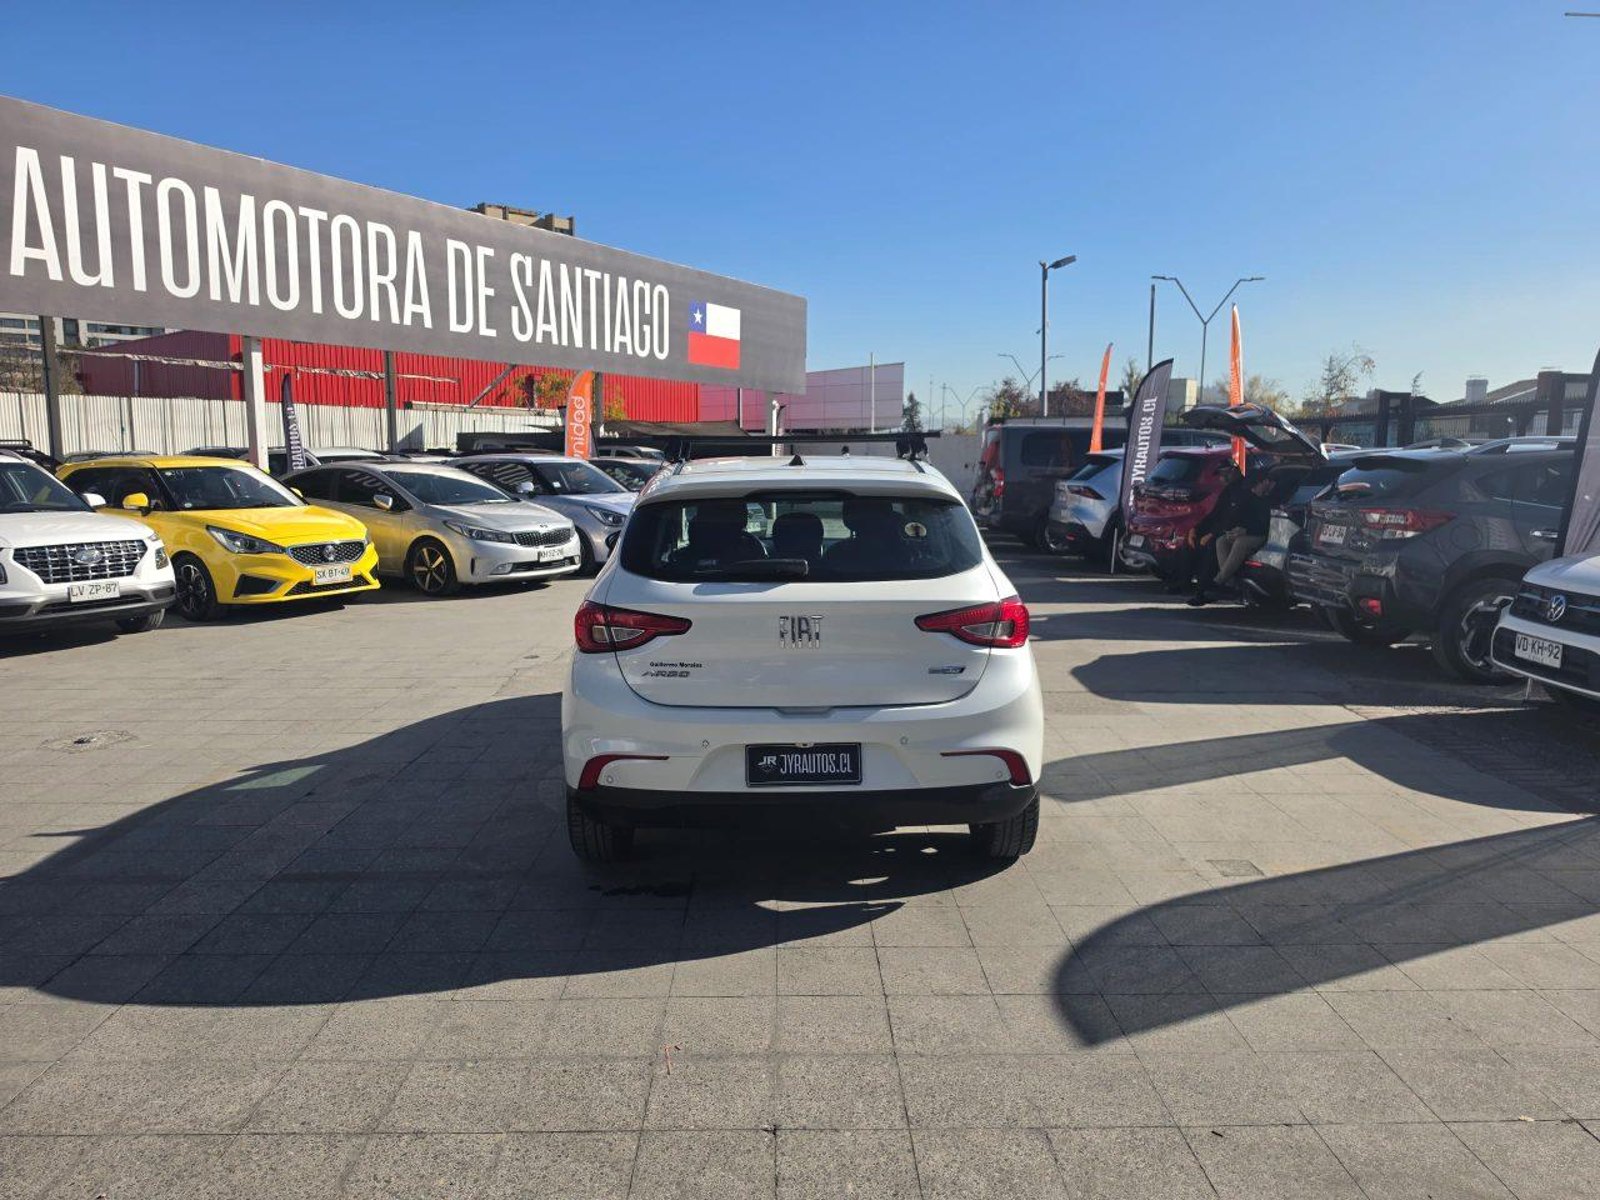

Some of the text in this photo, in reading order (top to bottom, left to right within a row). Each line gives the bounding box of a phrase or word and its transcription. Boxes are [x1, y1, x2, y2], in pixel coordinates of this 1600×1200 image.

[10, 146, 669, 360] AUTOMOTORA DE SANTIAGO
[779, 614, 823, 649] FIAT
[780, 753, 853, 774] JYRAUTOS.CL
